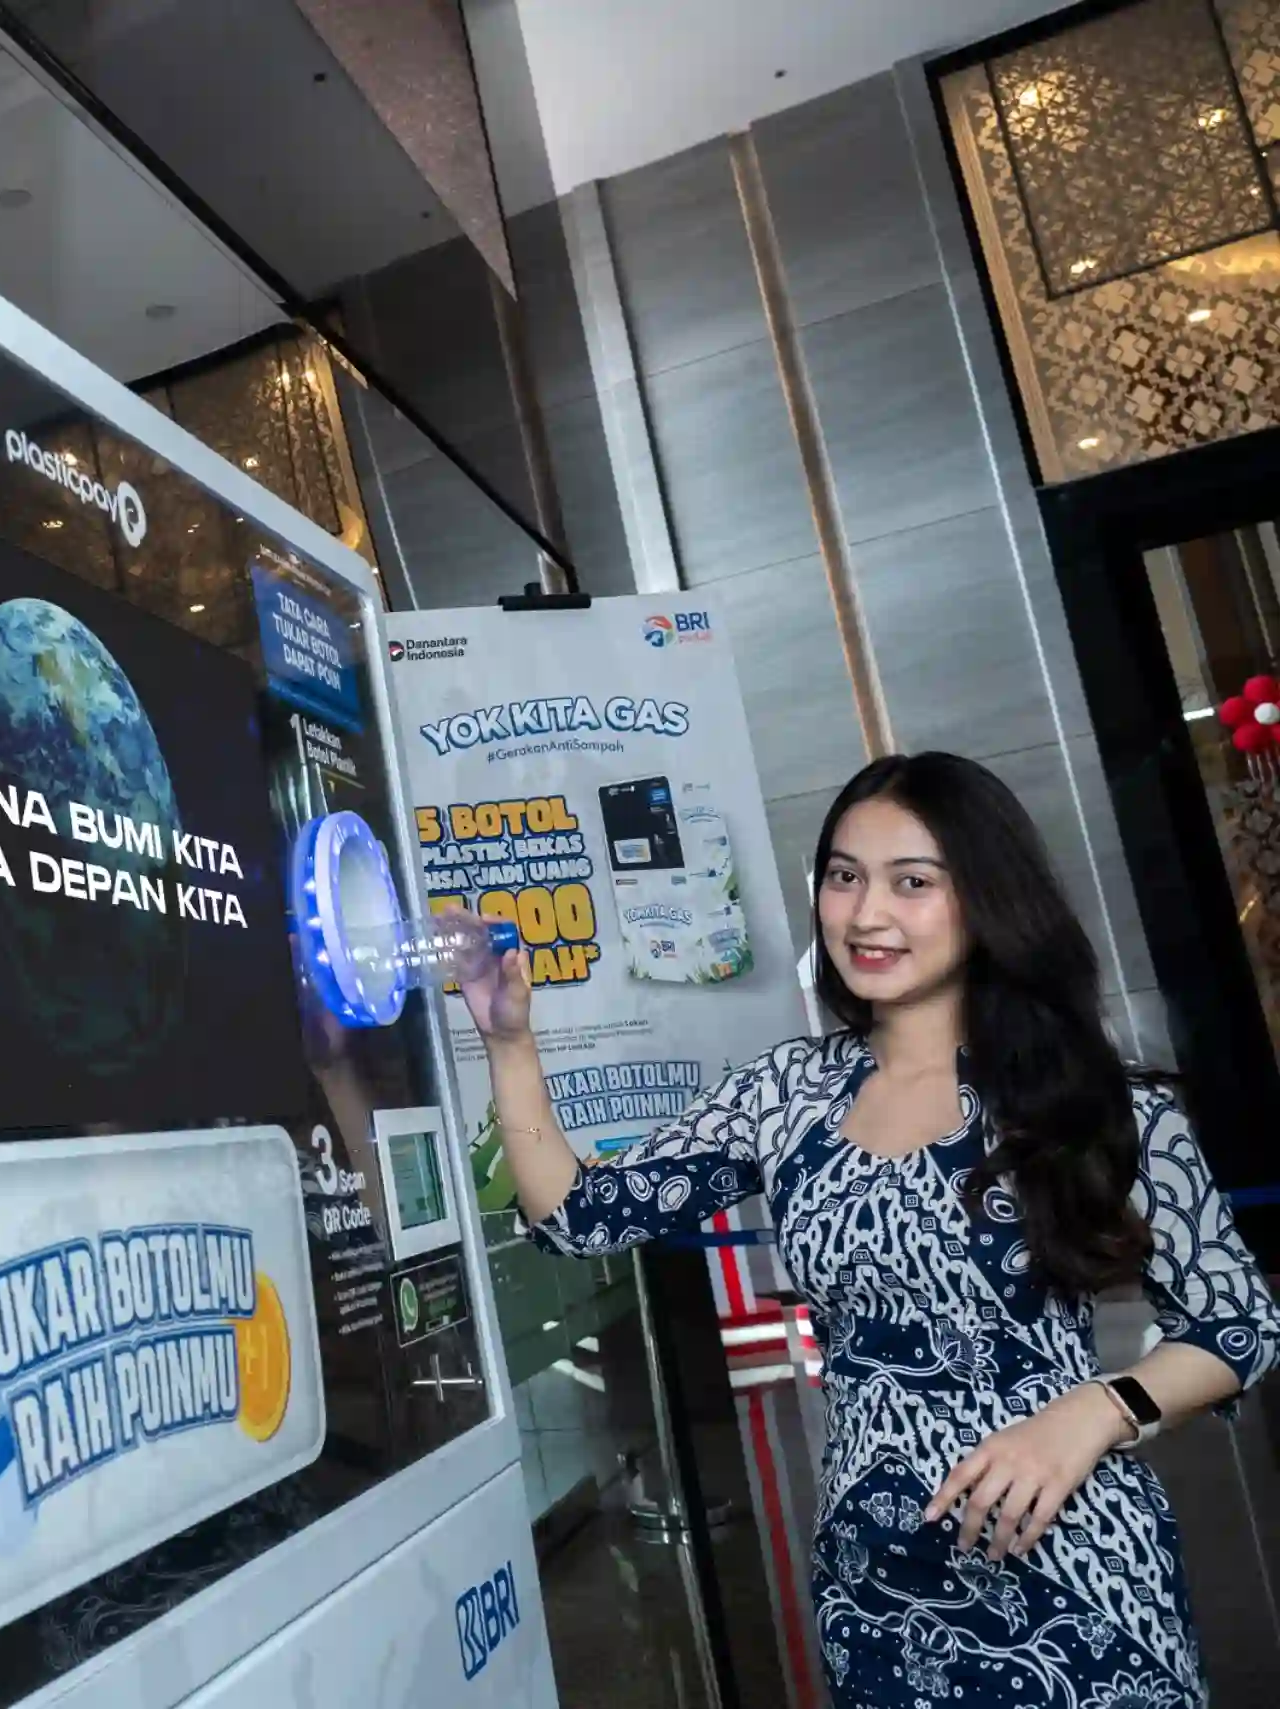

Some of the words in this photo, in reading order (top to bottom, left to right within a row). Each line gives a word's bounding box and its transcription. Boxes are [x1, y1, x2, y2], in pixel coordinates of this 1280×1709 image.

[5, 429, 118, 522] plasticpay
[675, 612, 710, 631] BRI
[406, 636, 468, 649] Danantara
[407, 647, 465, 661] Indonesia
[422, 701, 510, 755] YOK
[510, 696, 600, 736] KITA
[605, 697, 689, 736] GAS
[487, 738, 624, 763] #GerakanAntiSampah
[415, 806, 442, 843] 5
[448, 795, 578, 841] BOTOL
[69, 801, 163, 859] BUMI
[172, 829, 245, 880] KITA
[422, 840, 511, 866] PLASTIK
[514, 833, 585, 860] BEKAS
[29, 850, 167, 914] DEPAN
[176, 882, 248, 929] KITA
[473, 863, 525, 887] JADI
[528, 857, 592, 883] UANG
[545, 1068, 603, 1100] UKAR
[604, 1062, 699, 1091] BOTOLMU
[559, 1098, 607, 1130] RAIH
[609, 1092, 683, 1120] POINMU
[311, 1124, 338, 1195] 3
[339, 1170, 366, 1193] Scan
[323, 1207, 342, 1235] QR
[342, 1203, 371, 1231] Code
[102, 1231, 255, 1330] BOTOLMU
[13, 1357, 115, 1498] RAIH
[115, 1332, 238, 1441] POINMU
[480, 1560, 519, 1652] BRI
